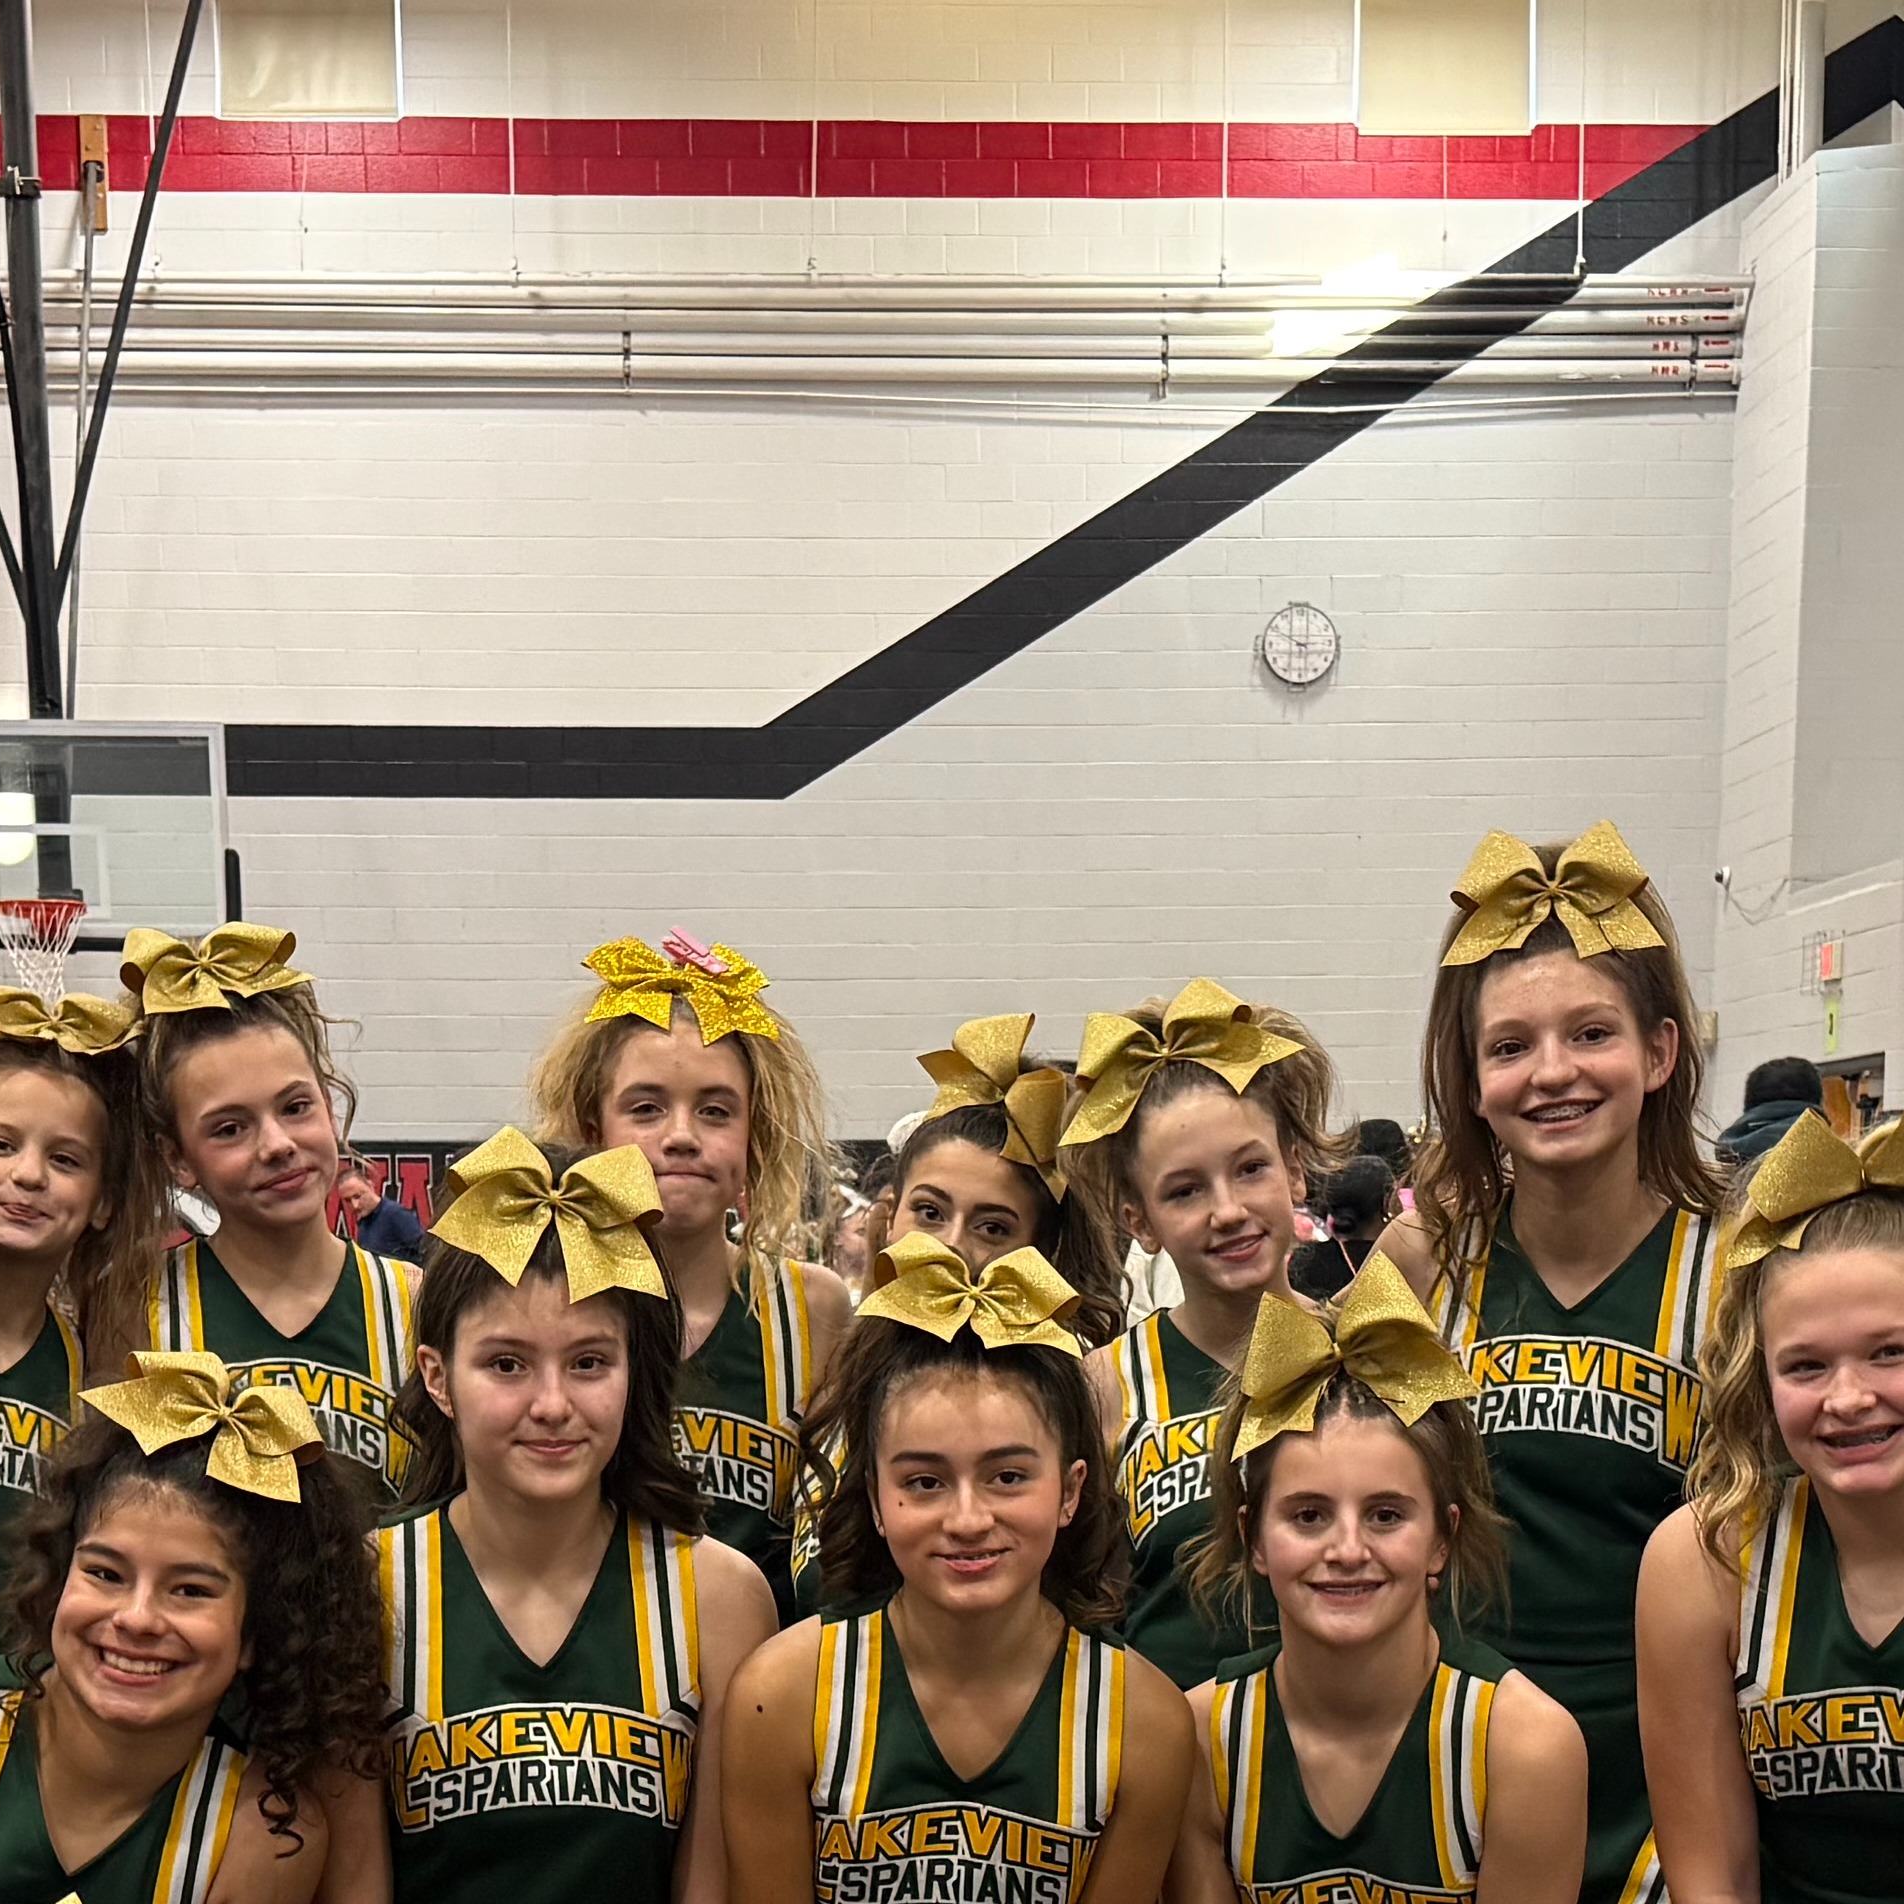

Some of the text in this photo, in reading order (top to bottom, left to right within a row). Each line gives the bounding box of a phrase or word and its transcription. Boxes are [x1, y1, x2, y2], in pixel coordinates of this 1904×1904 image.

[1463, 1334, 1703, 1474] KEVIEW
[393, 1703, 694, 1834] LAKEVIEW
[432, 1757, 661, 1822] SPARTANS
